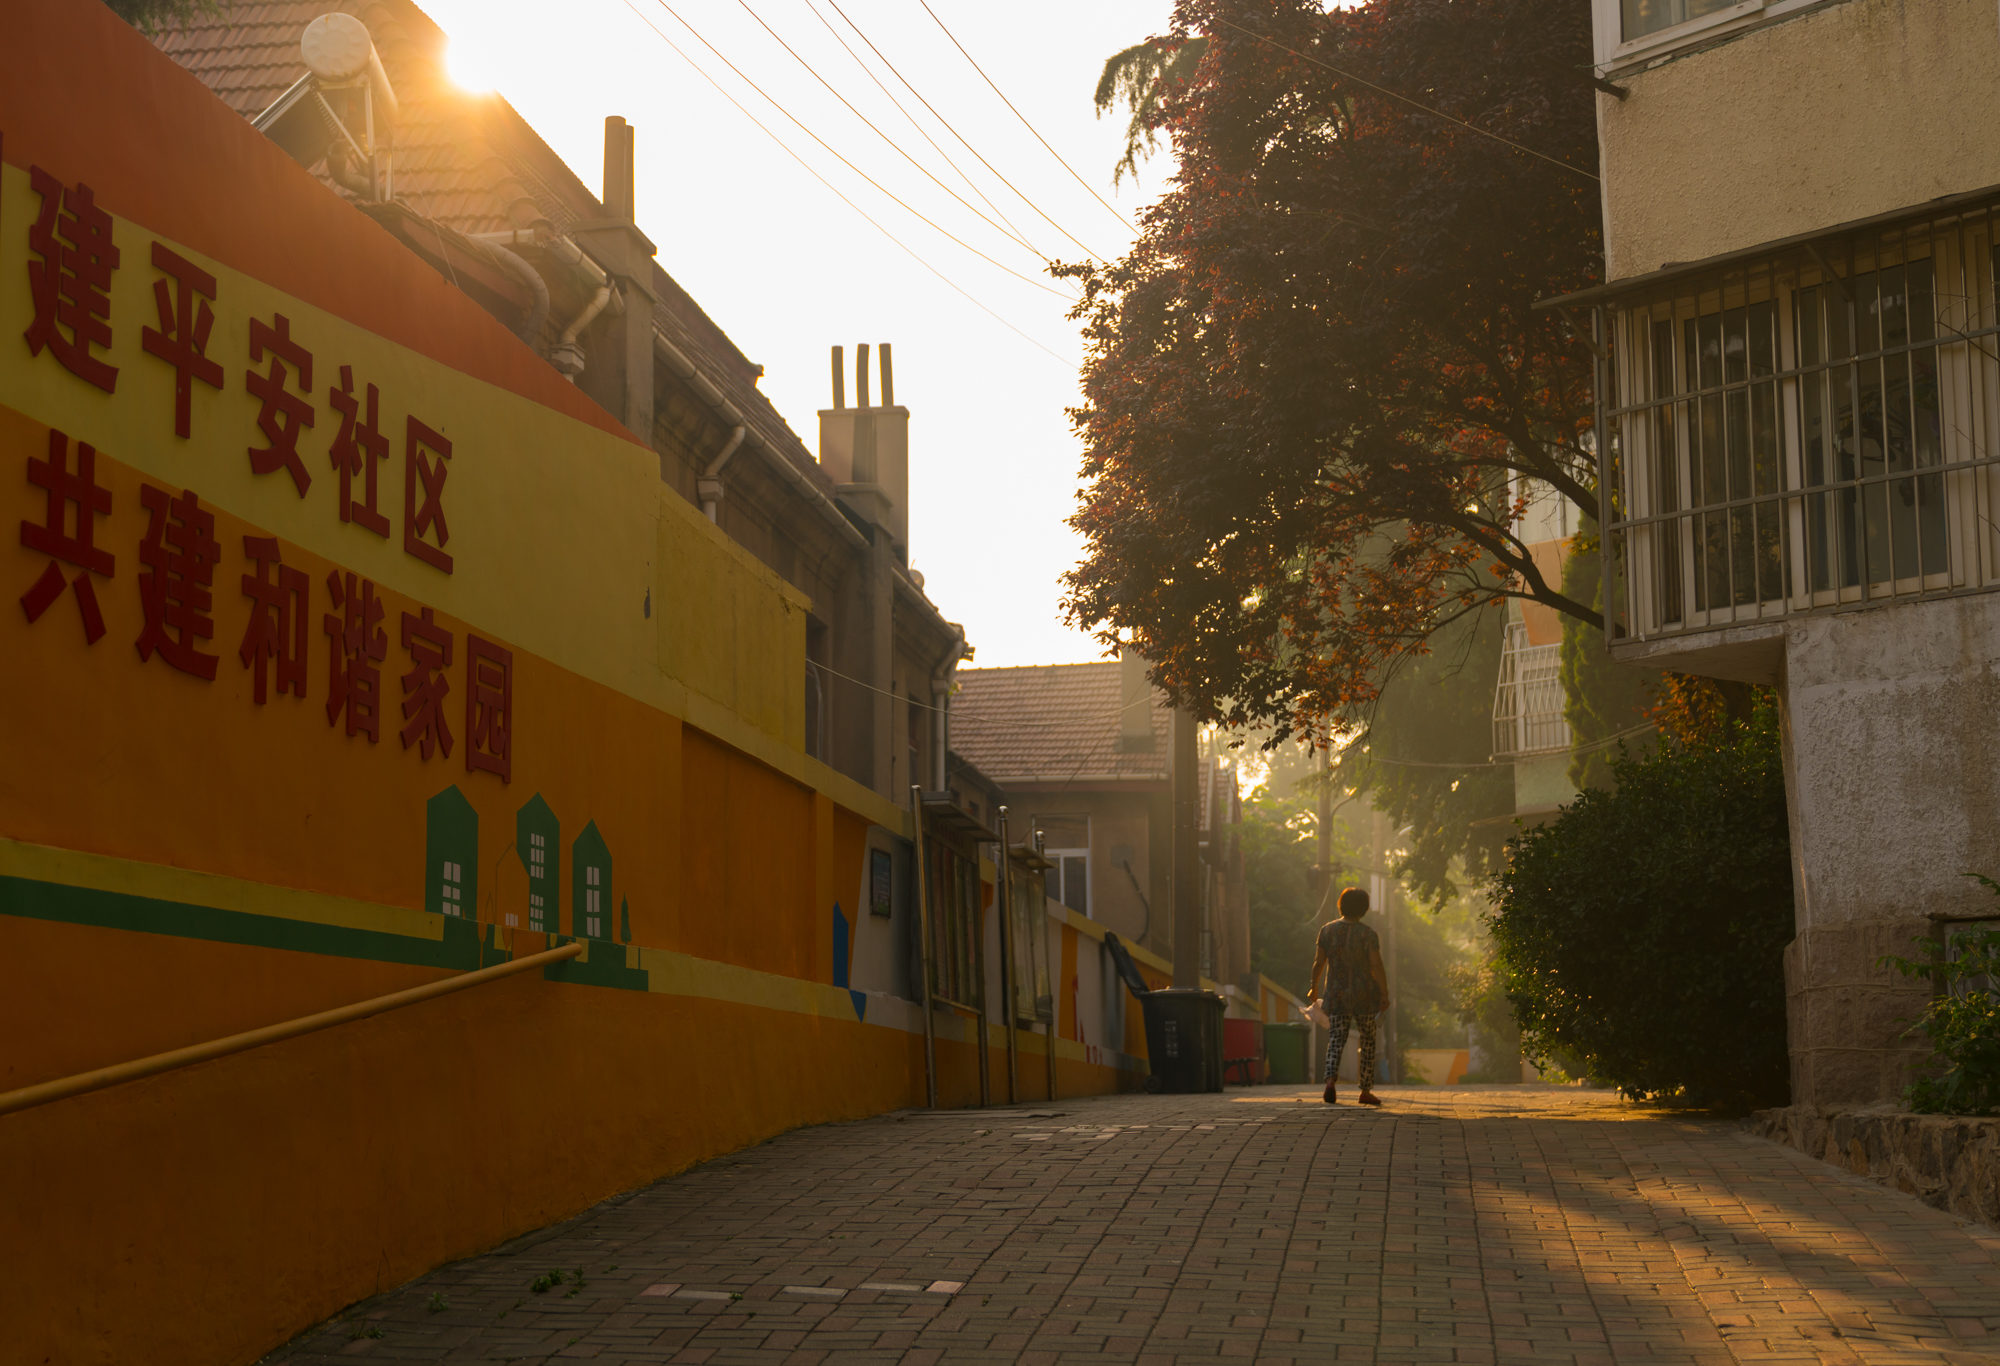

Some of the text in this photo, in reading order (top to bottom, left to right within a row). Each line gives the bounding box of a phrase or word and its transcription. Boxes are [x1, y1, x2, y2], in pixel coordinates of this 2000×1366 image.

[0, 131, 454, 574] 建平安社区
[19, 428, 513, 785] 共建和谐家园
